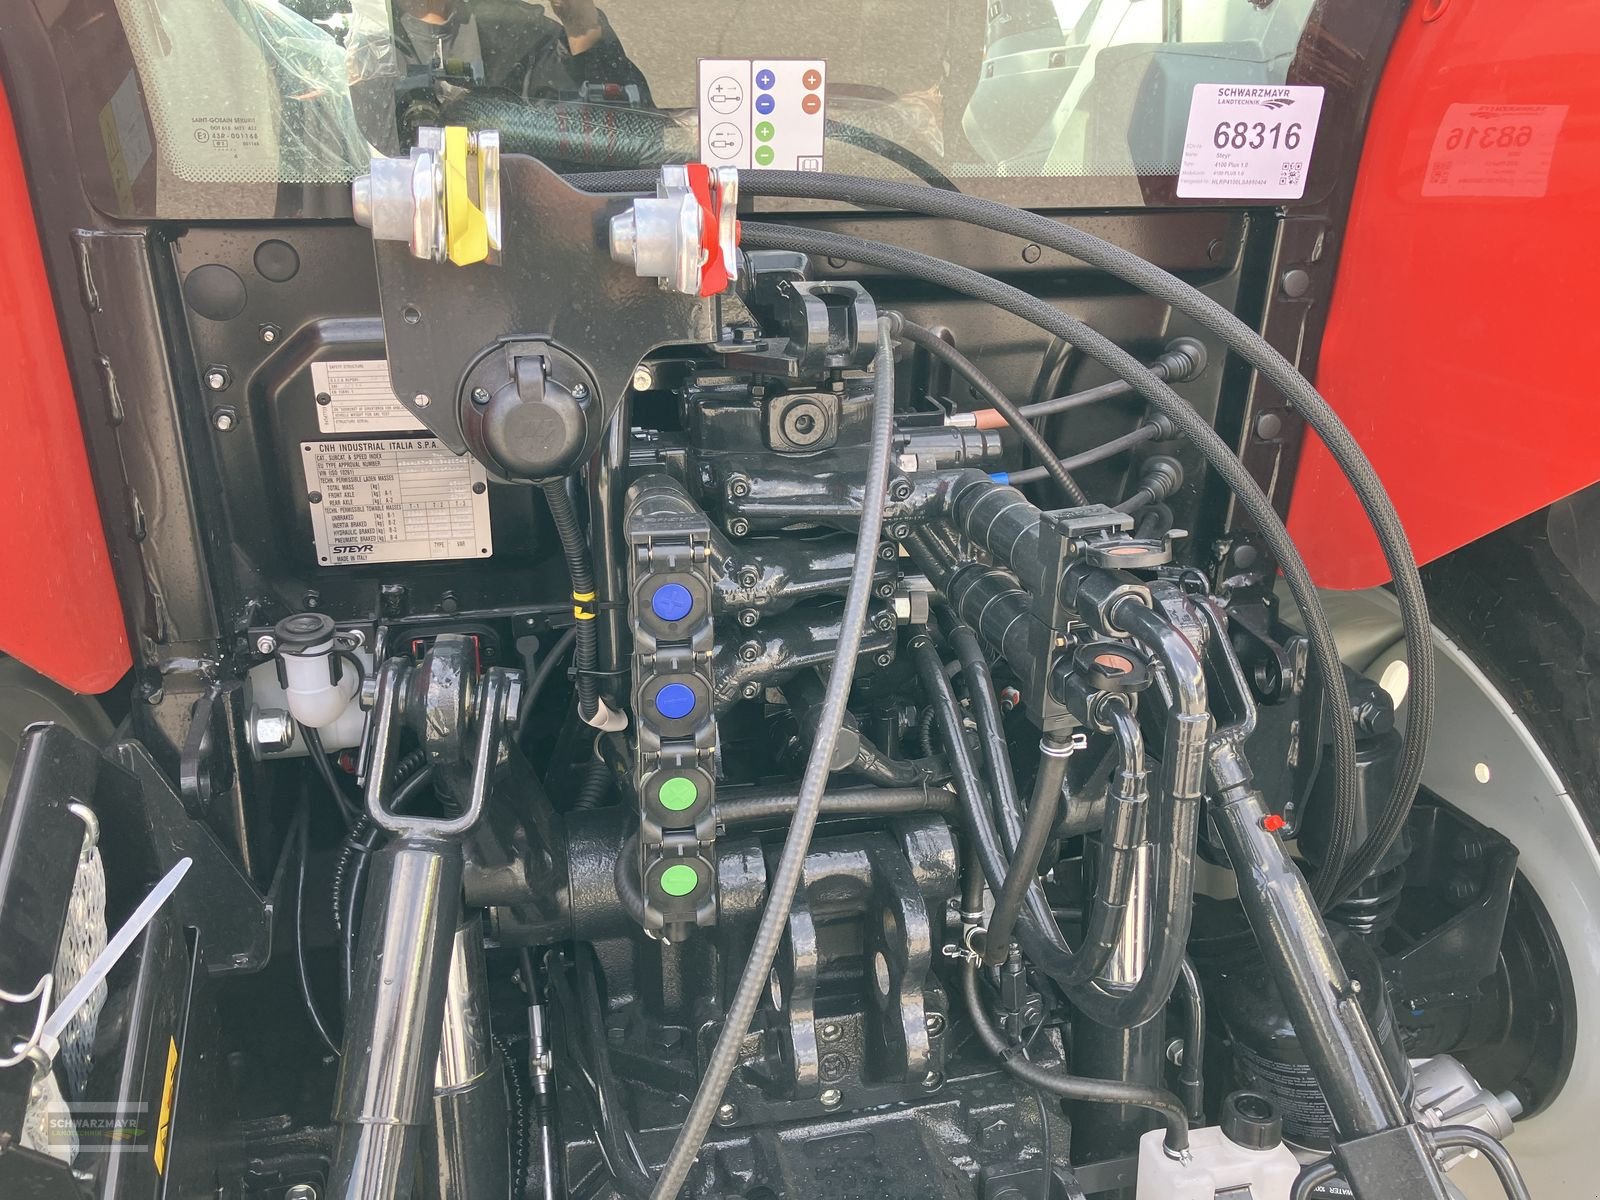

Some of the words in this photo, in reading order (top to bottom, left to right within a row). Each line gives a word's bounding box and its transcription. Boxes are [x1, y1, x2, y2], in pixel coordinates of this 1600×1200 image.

[1218, 88, 1290, 98] SCHWARZMAYR
[1214, 122, 1302, 150] 68316
[320, 444, 336, 452] CNH
[340, 443, 385, 451] INDUSTRIAL
[390, 442, 413, 450] ITALIA
[417, 441, 439, 449] S.P.A.
[333, 545, 373, 554] STEYR
[1329, 1187, 1353, 1196] WATER
